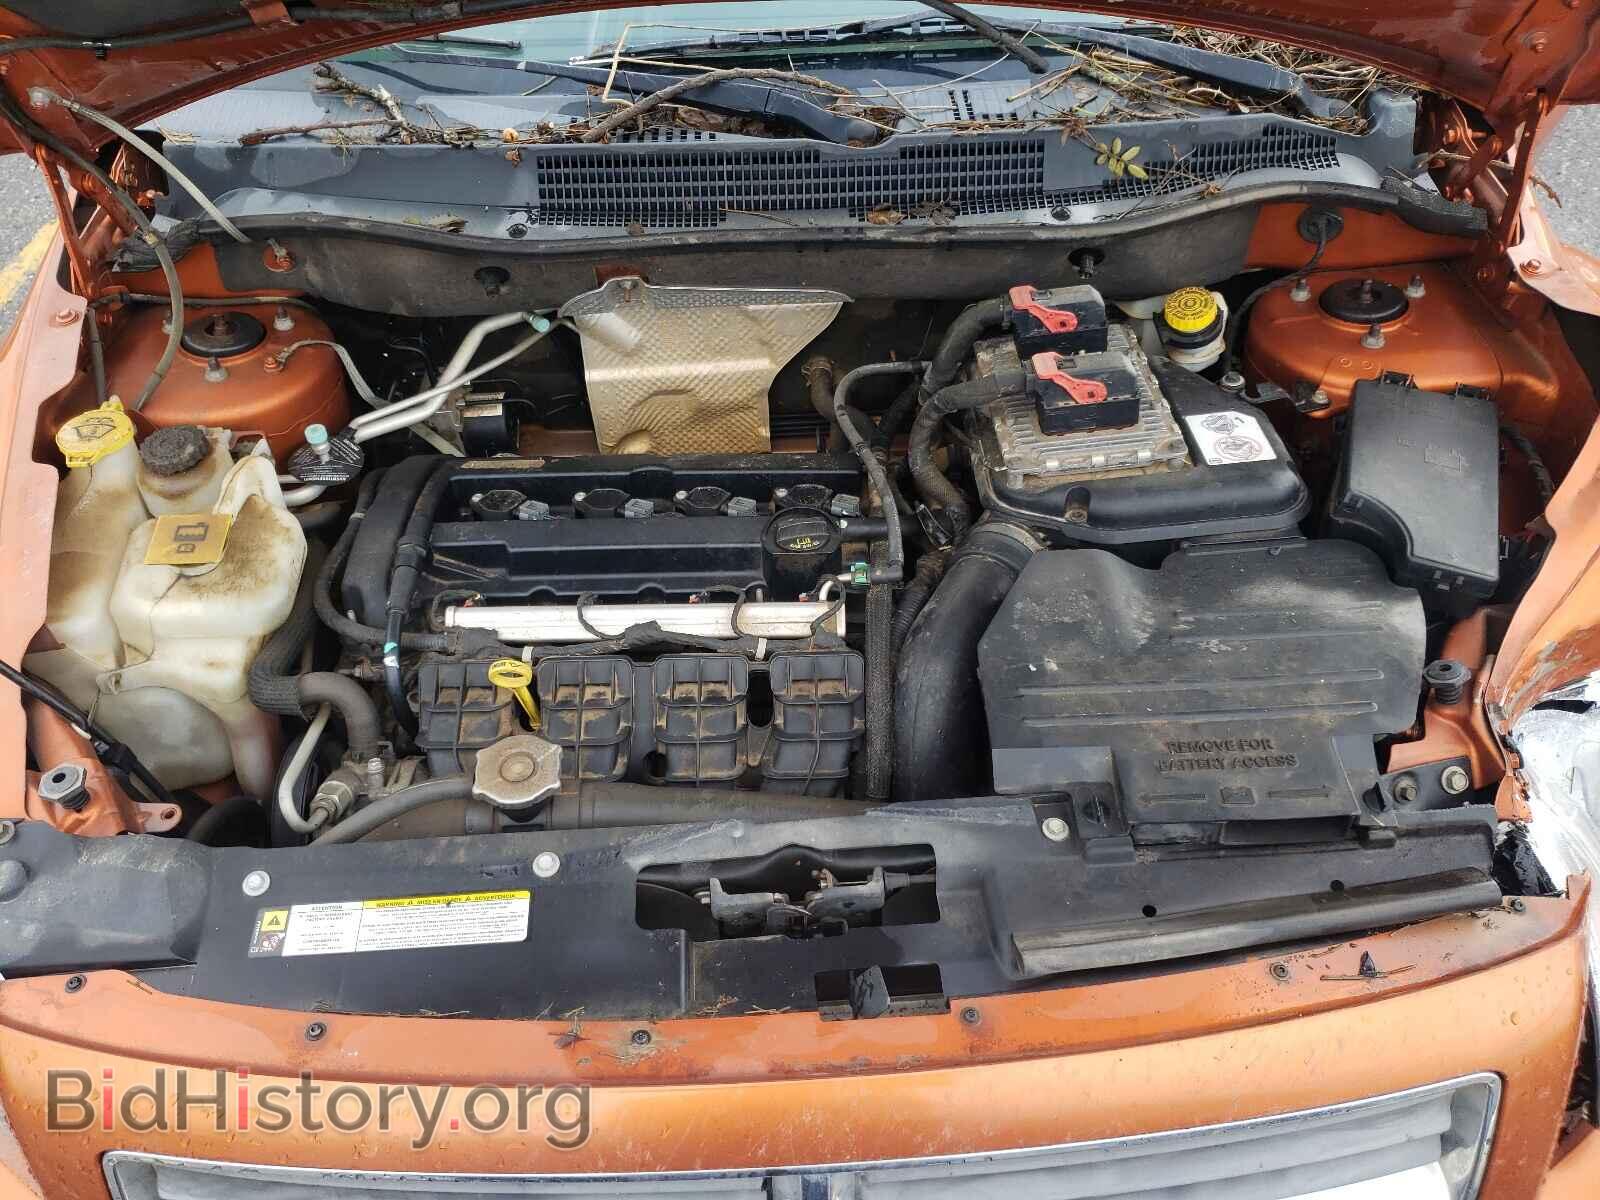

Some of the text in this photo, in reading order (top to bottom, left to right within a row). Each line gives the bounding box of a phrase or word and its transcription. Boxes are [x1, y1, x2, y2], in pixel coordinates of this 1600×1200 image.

[1167, 738, 1274, 753] REMOVE FOR
[1158, 753, 1298, 772] BATTERY ACCESS
